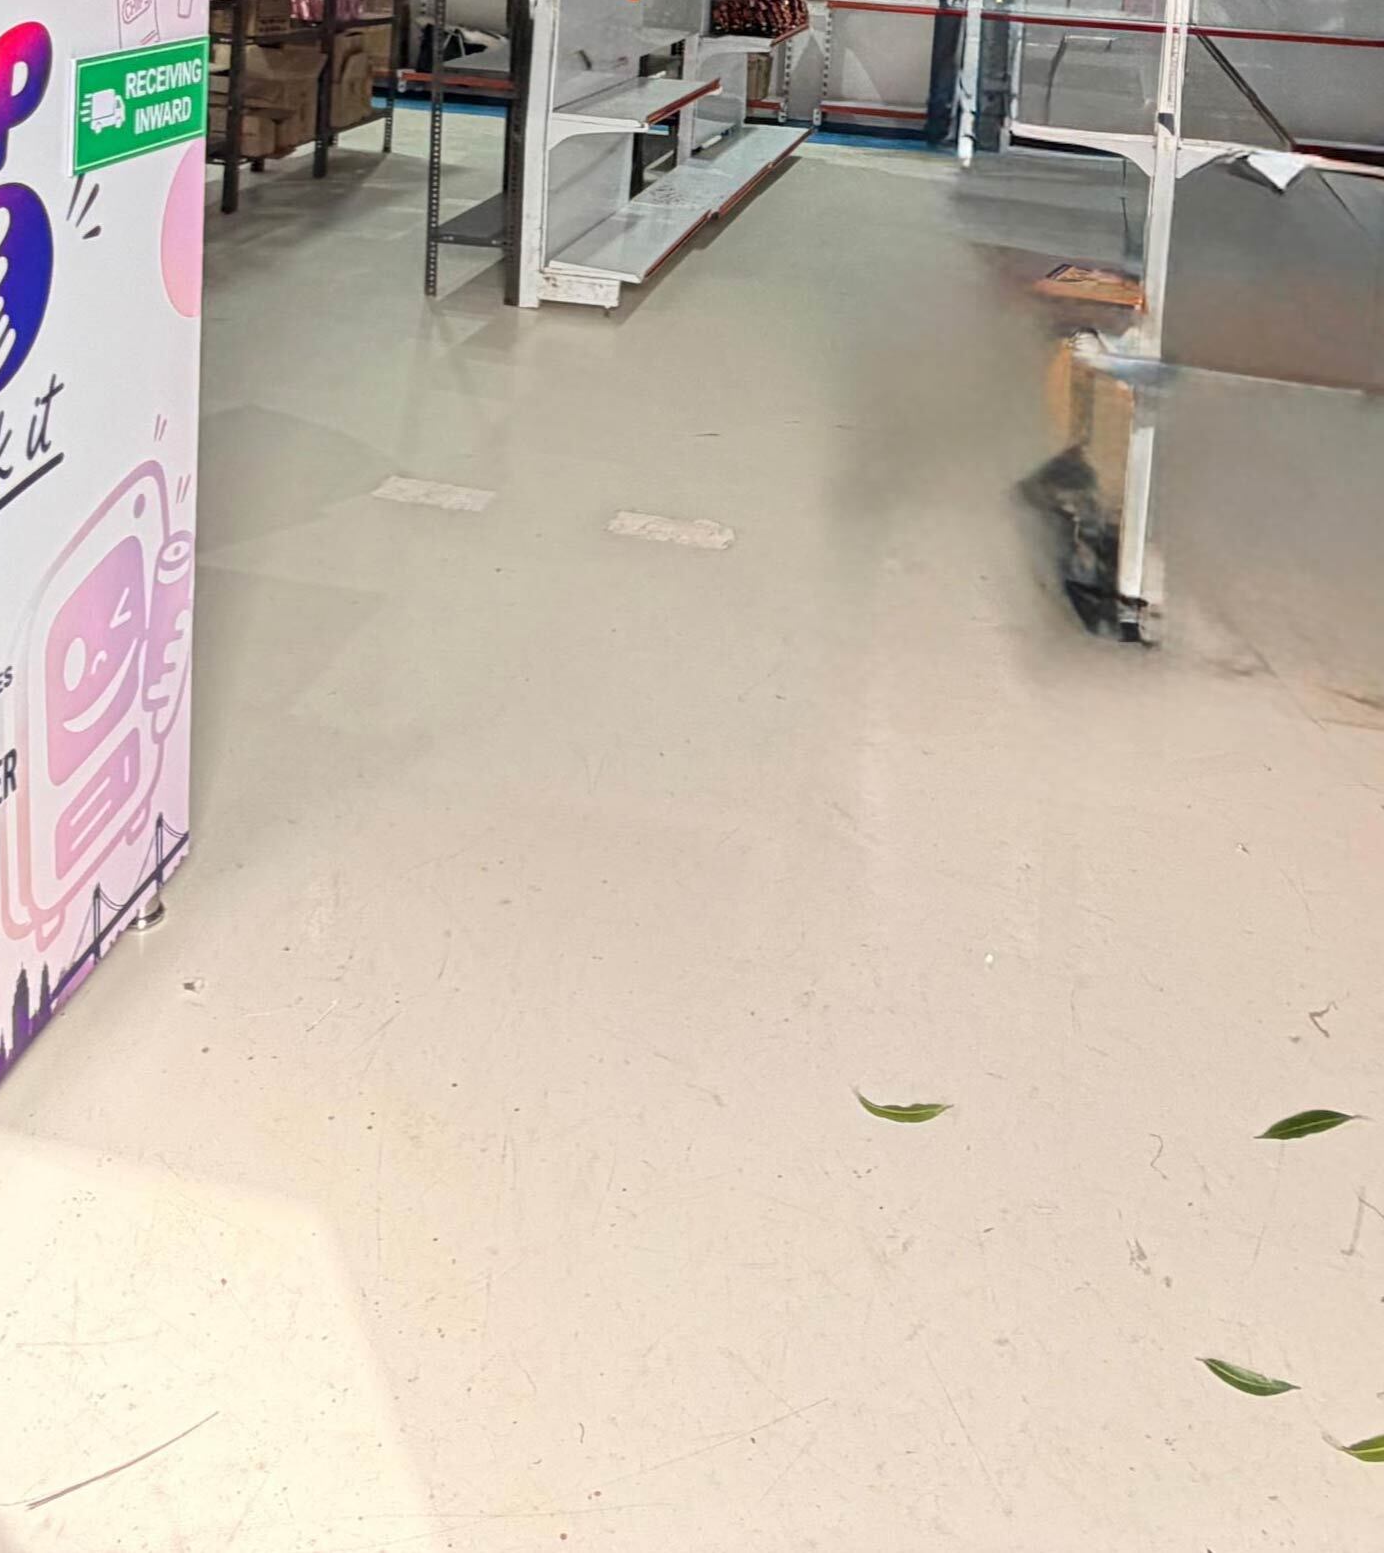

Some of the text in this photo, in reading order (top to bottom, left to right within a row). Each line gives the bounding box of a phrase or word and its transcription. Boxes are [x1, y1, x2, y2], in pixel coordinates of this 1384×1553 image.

[125, 58, 203, 100] RECEIVING
[134, 96, 192, 135] INWARD
[25, 373, 65, 469] it
